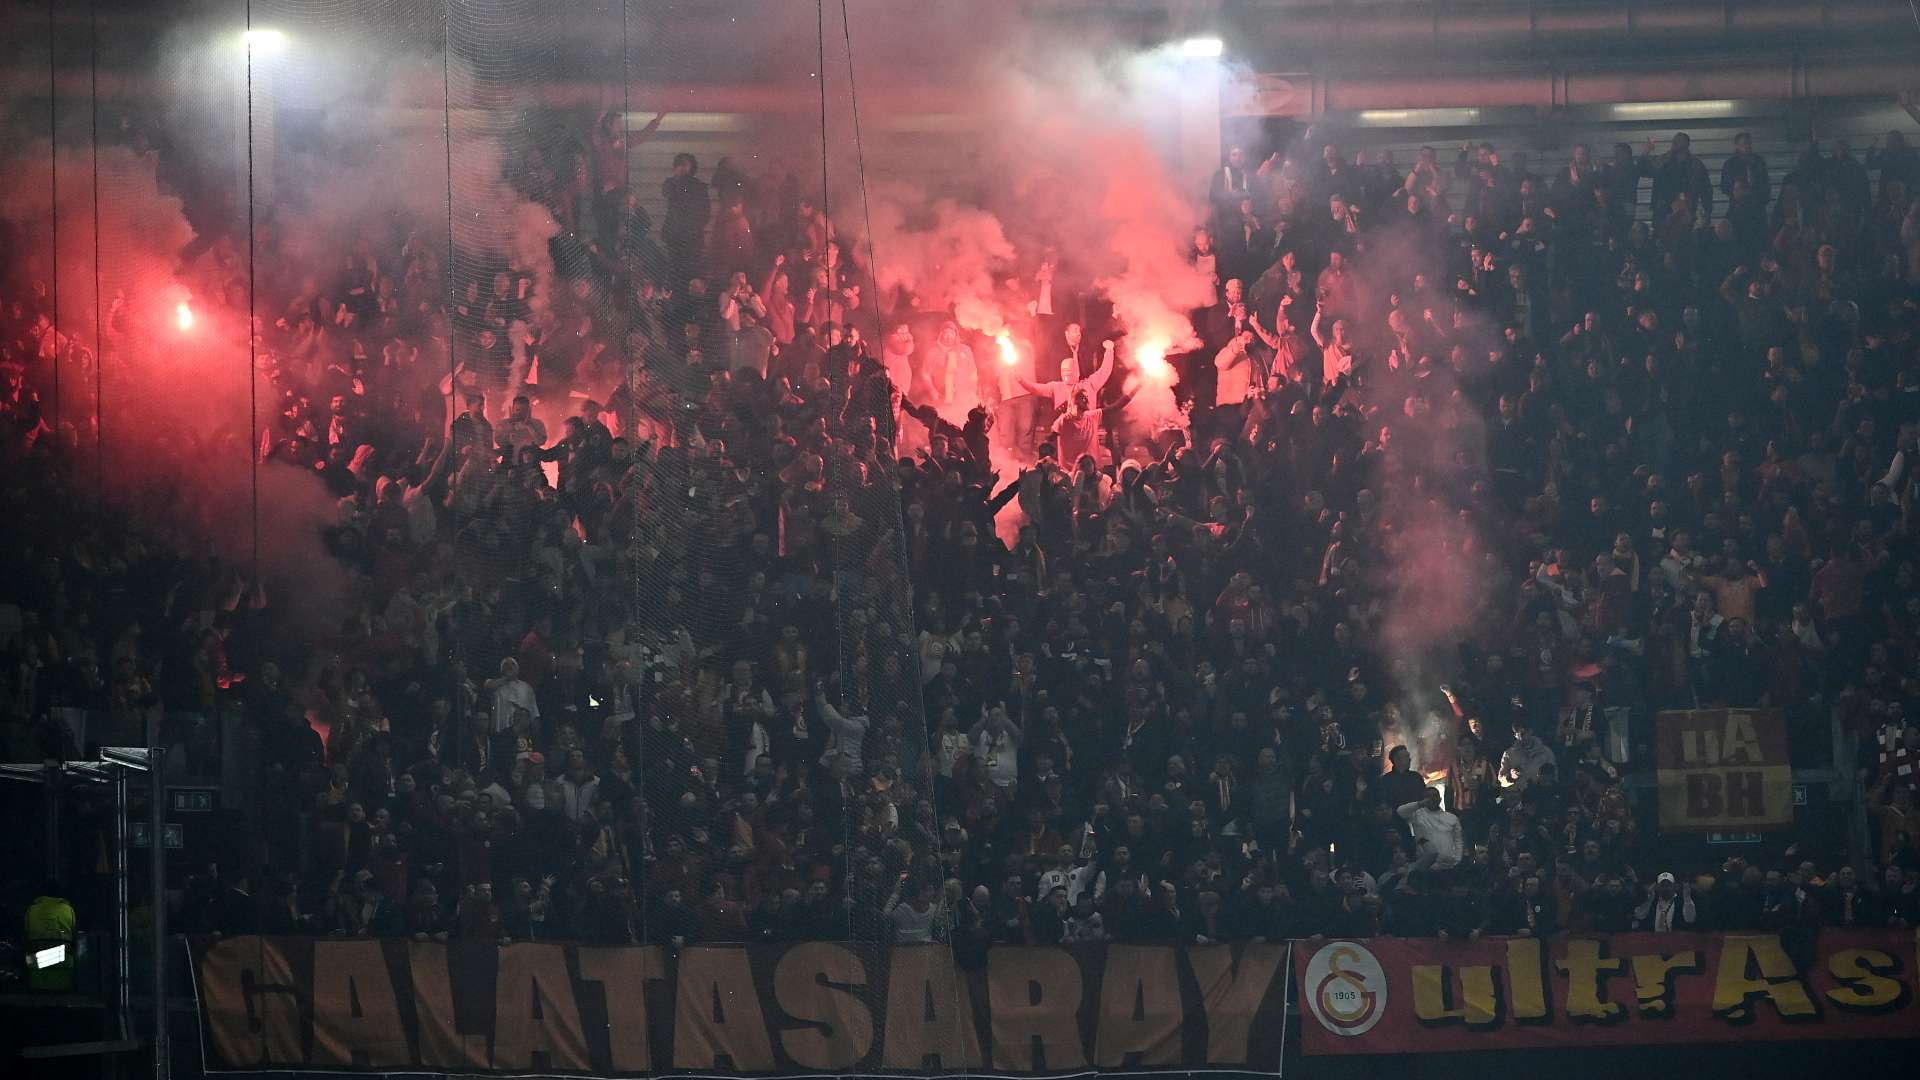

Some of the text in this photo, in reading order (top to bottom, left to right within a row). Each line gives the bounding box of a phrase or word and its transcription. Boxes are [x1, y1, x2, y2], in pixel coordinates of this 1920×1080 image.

[1685, 771, 1766, 817] BH
[200, 935, 1288, 1073] GALATASARAY
[1334, 991, 1356, 1000] 1905
